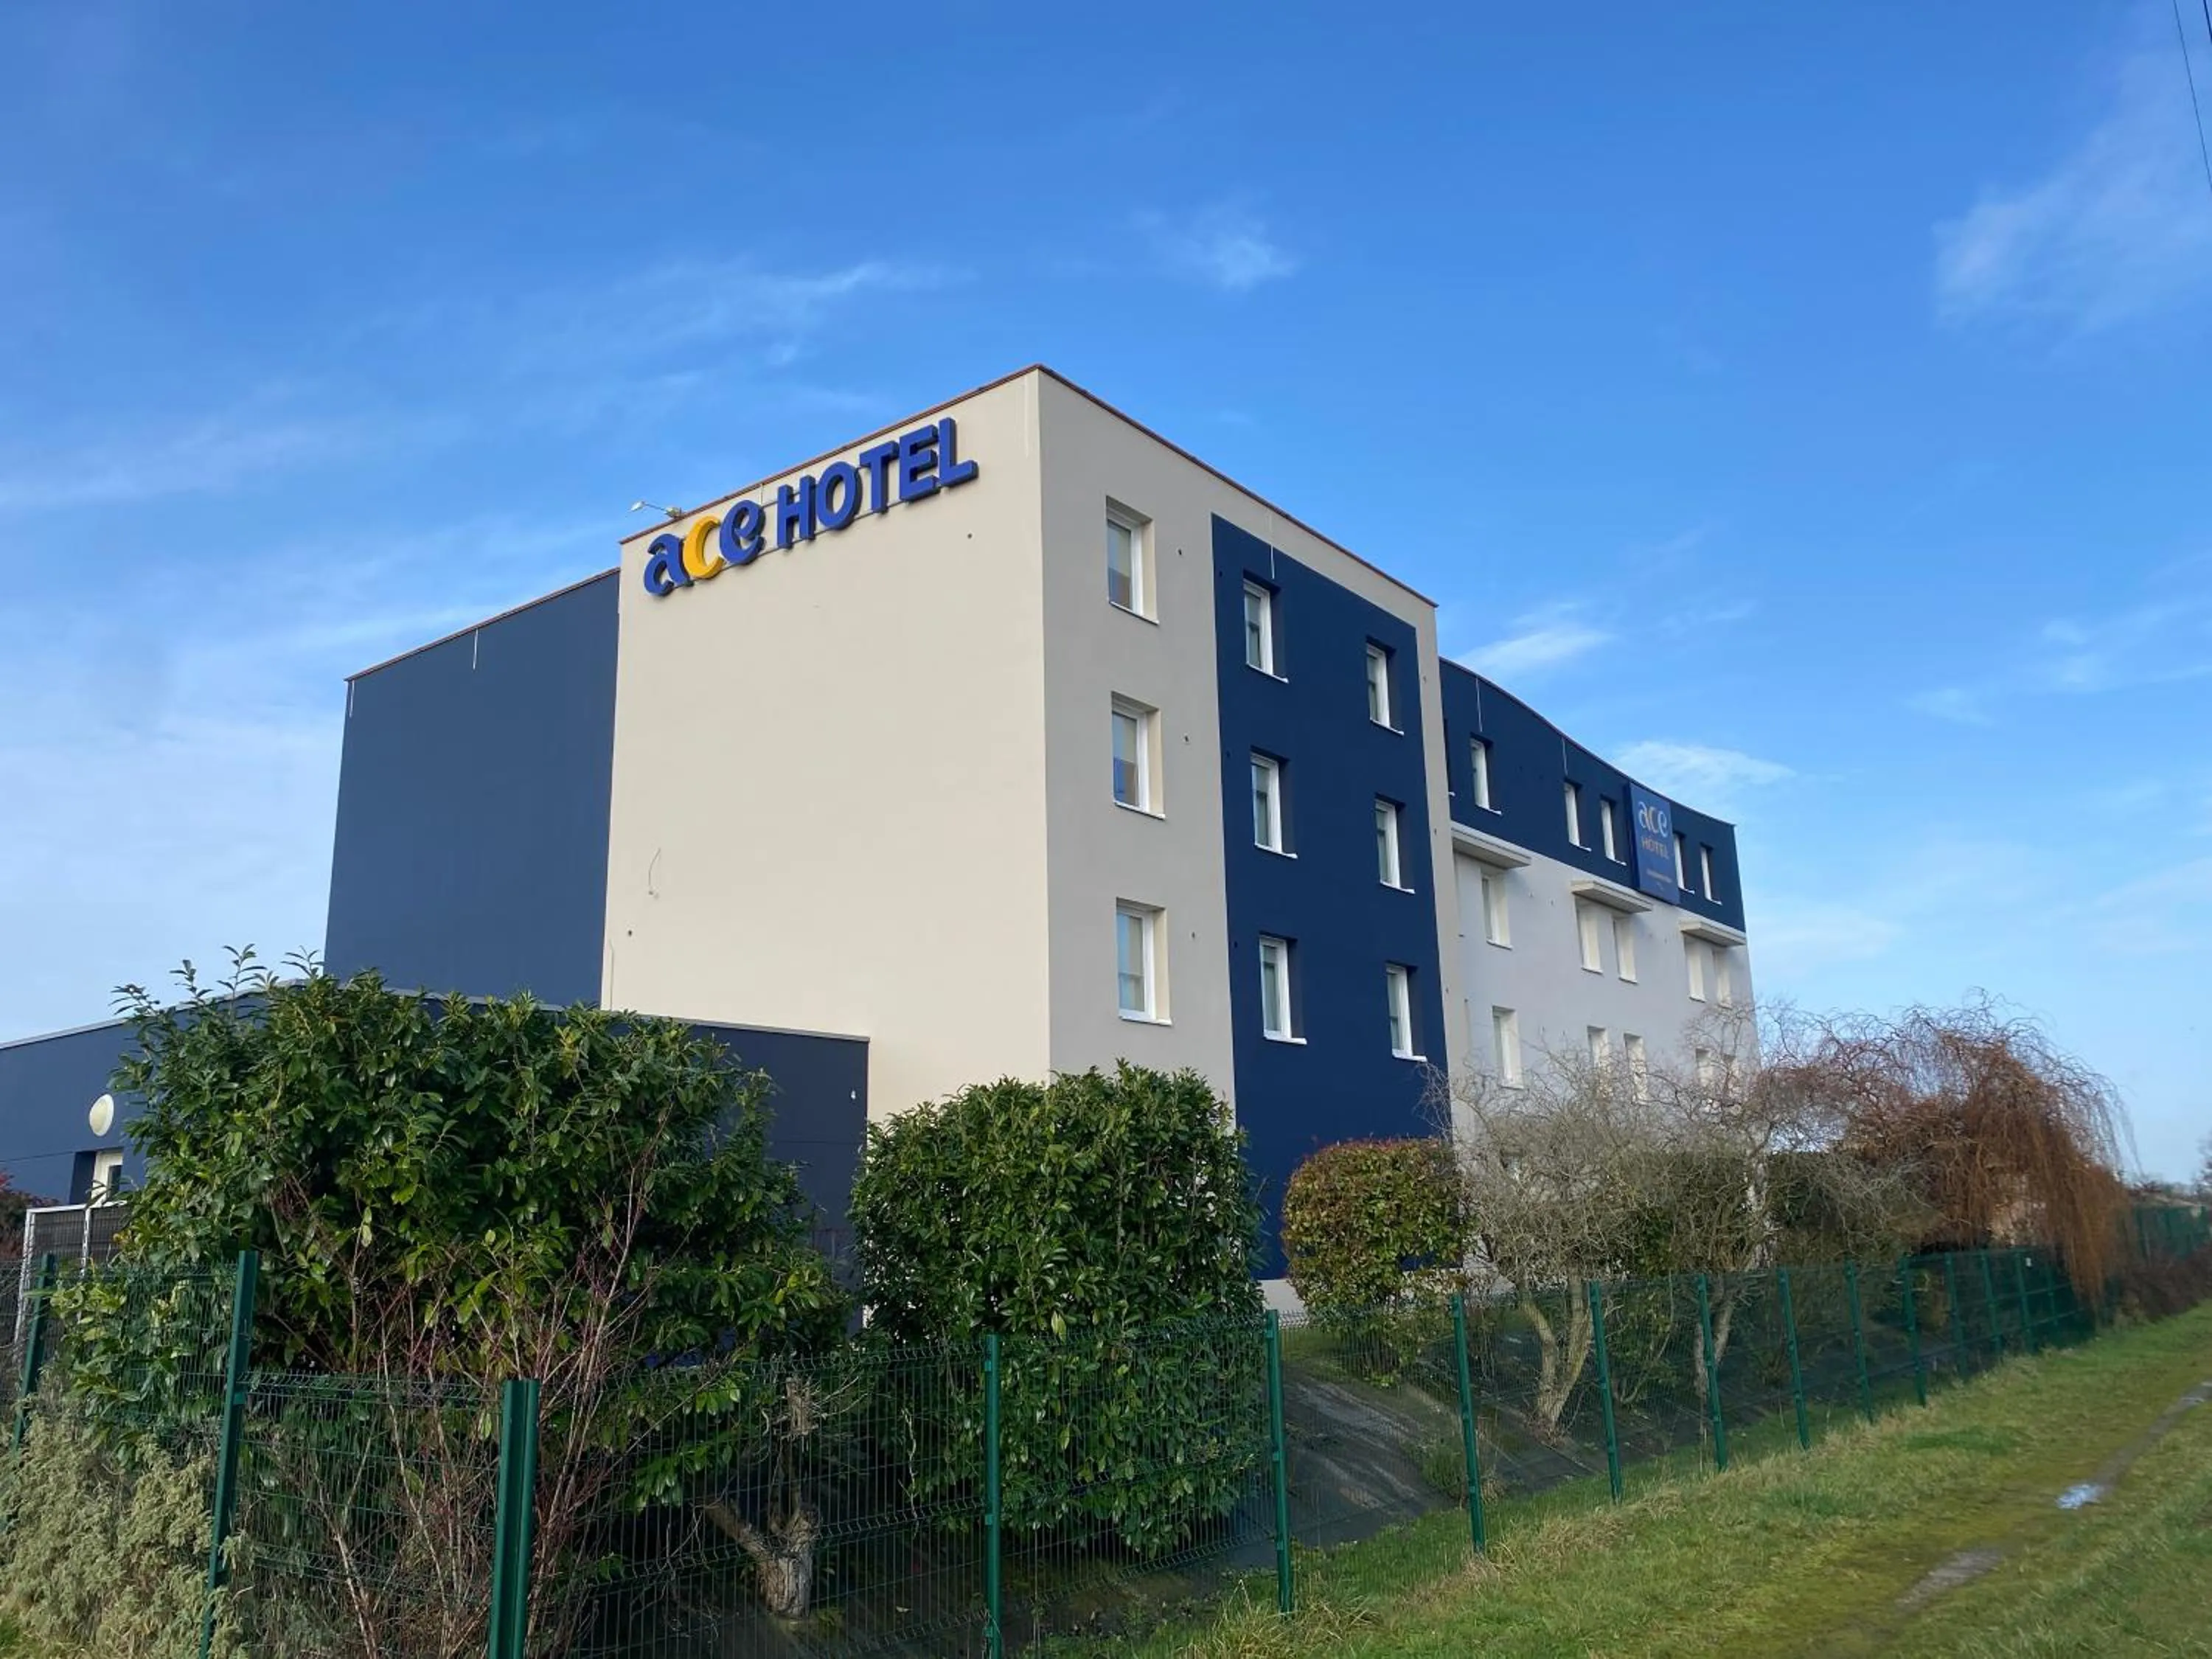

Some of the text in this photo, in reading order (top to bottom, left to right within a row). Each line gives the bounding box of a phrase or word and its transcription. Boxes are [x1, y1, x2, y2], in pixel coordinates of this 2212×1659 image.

[643, 417, 978, 596] ace HOTEL
[1638, 801, 1668, 838] ace
